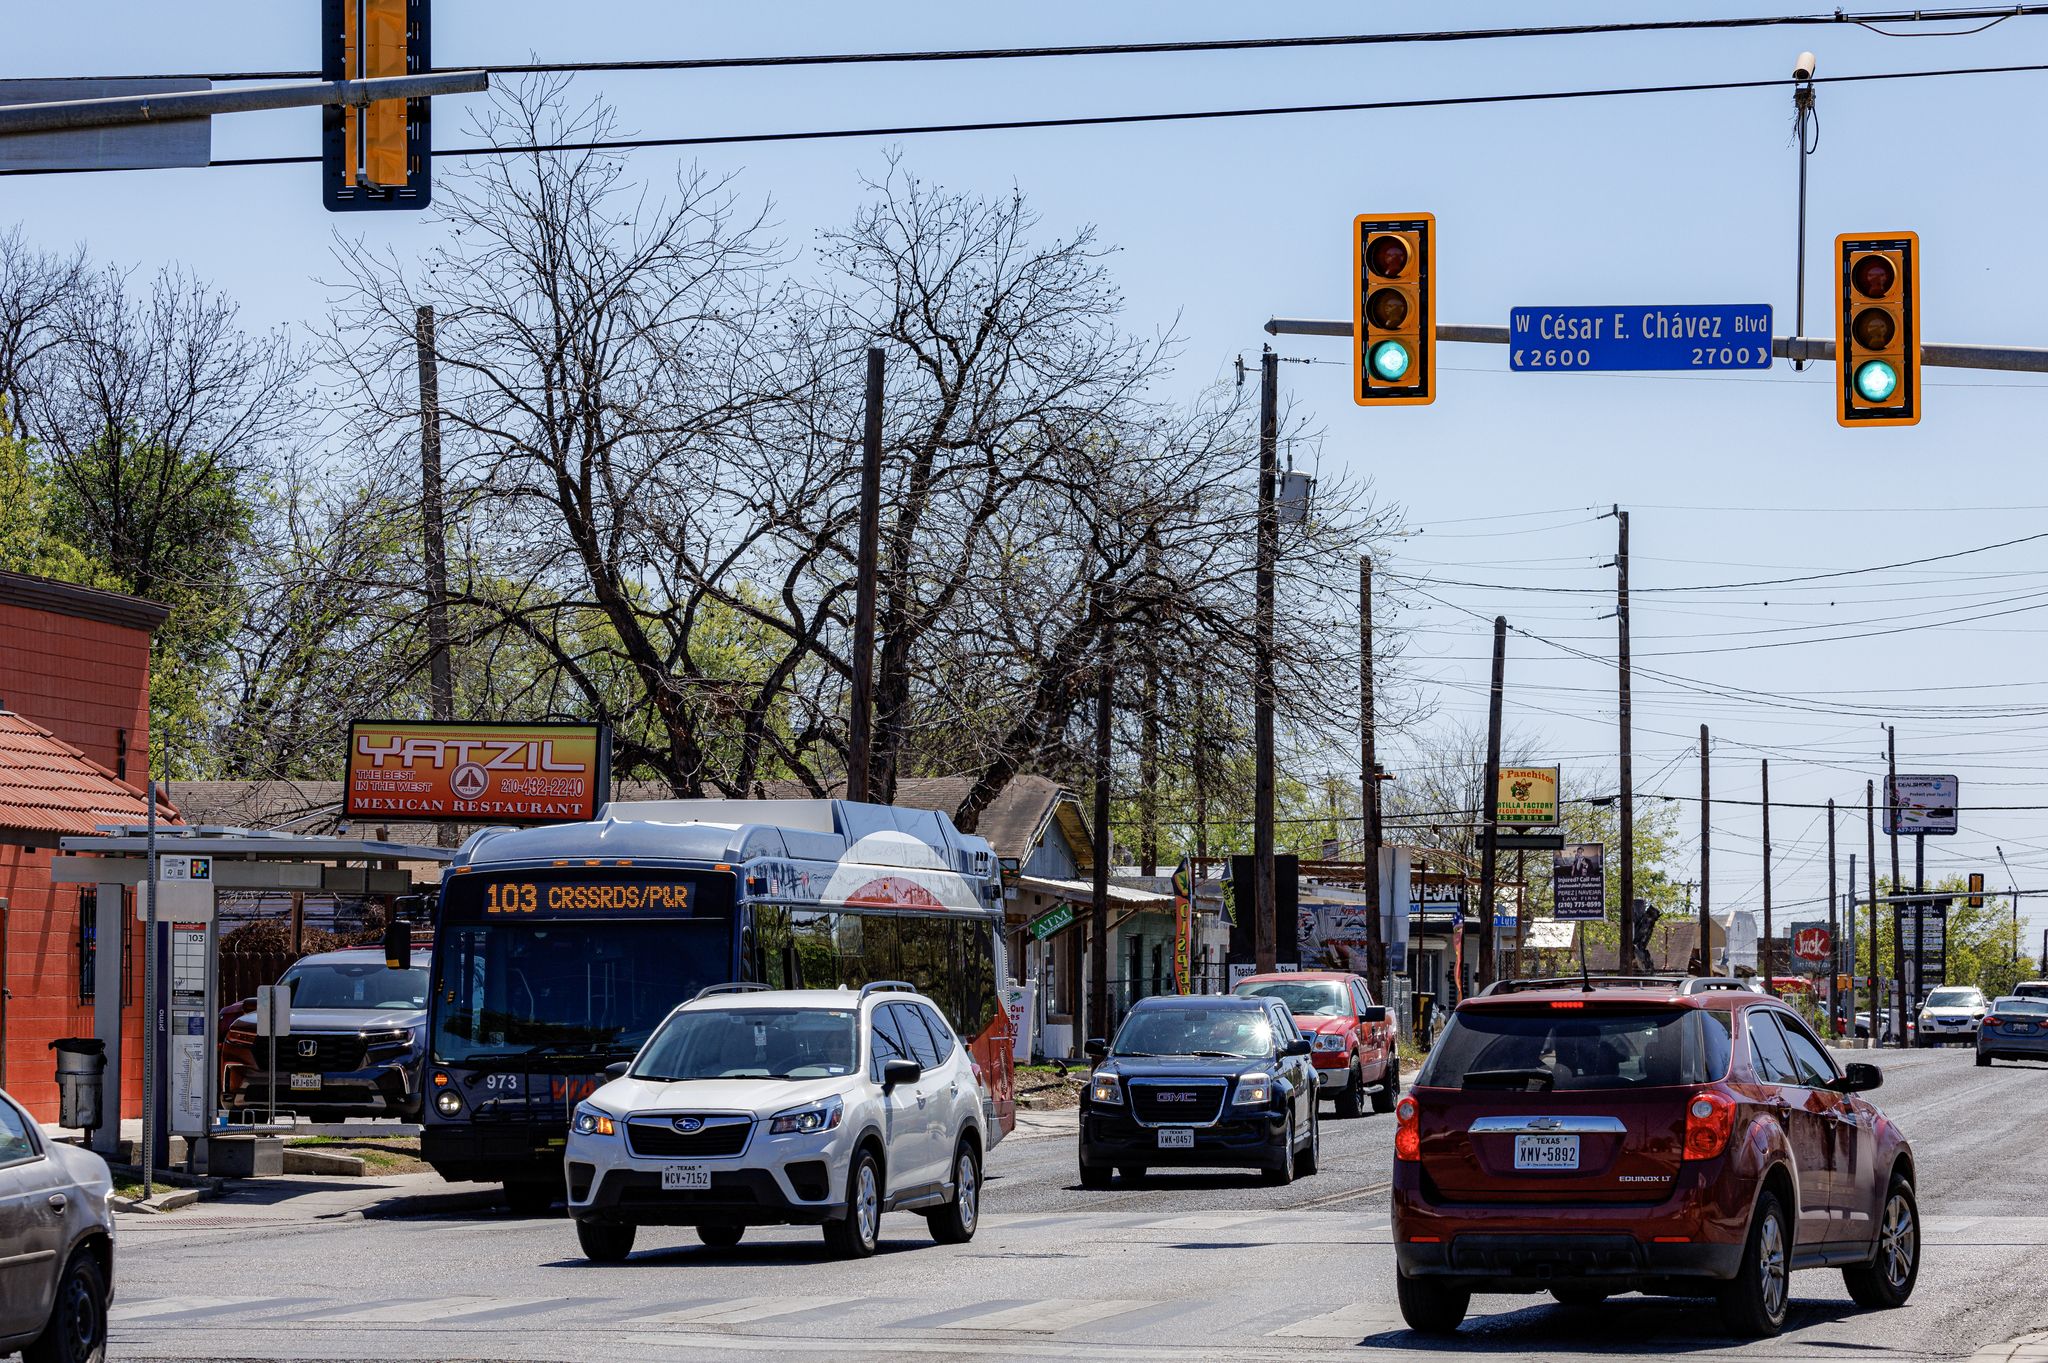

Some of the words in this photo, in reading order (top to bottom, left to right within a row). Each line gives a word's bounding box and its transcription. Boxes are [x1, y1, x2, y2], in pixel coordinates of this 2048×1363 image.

[1515, 314, 1530, 333] W
[1540, 313, 1603, 340] César
[1614, 313, 1630, 339] E.
[1642, 311, 1722, 339] Chávez
[1734, 314, 1767, 333] Blvd
[1530, 350, 1590, 366] 2600
[1692, 348, 1750, 365] 2700
[357, 736, 585, 772] YATZIL
[355, 769, 382, 781] THE
[382, 770, 416, 781] BEST
[355, 780, 368, 791] IN
[369, 781, 395, 792] THE
[396, 782, 432, 793] WEST
[500, 777, 584, 798] 210-432-2240
[353, 797, 445, 812] MEXICAN
[452, 800, 583, 815] RESTAURANT
[487, 883, 537, 913] 103
[548, 885, 688, 909] CRSSRDS/P&R
[1039, 909, 1068, 934] ATM
[189, 934, 204, 942] 103
[487, 1075, 517, 1090] 973
[552, 1078, 597, 1100] VIA
[1157, 1092, 1197, 1102] GMC
[1536, 1137, 1561, 1145] TEXAS
